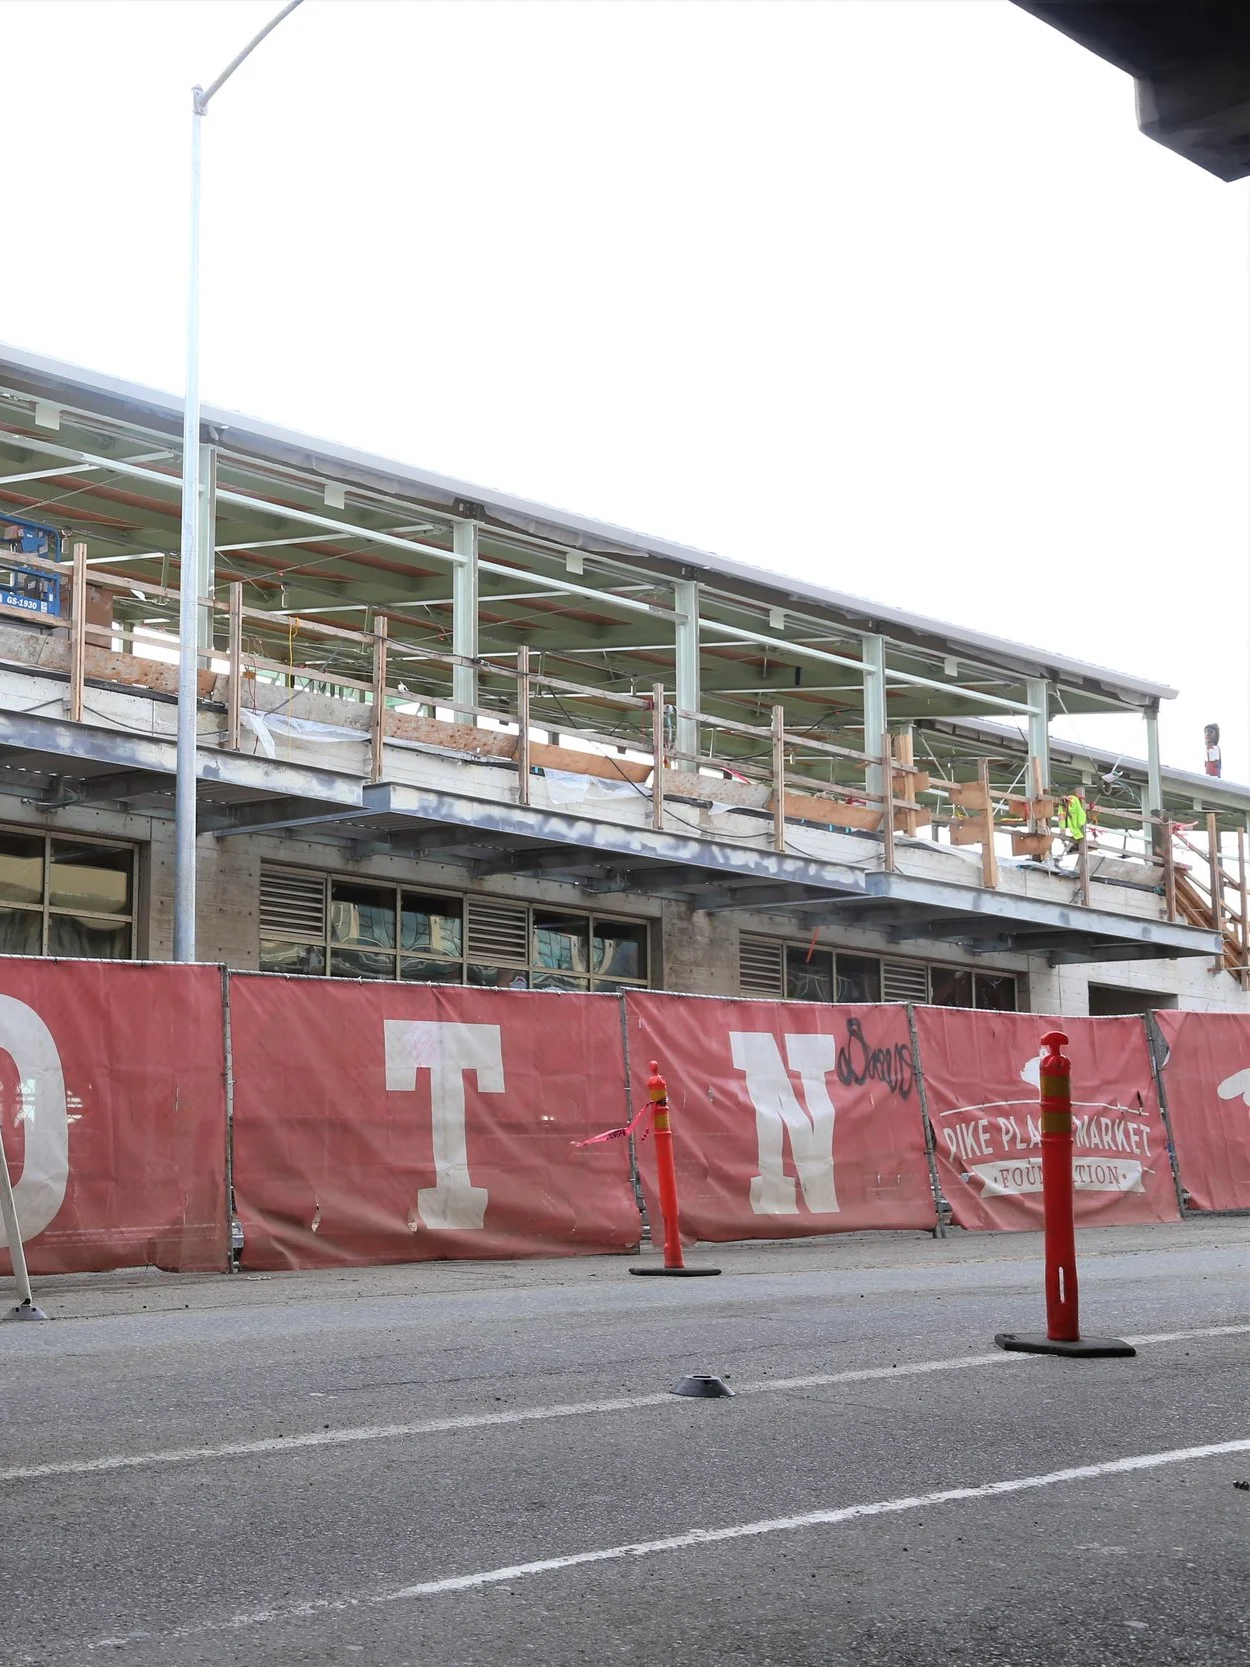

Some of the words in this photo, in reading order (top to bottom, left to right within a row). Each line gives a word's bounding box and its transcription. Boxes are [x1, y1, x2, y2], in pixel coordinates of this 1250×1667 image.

[6, 596, 38, 610] GS-1930
[383, 1019, 505, 1229] T
[729, 1031, 841, 1215] N
[943, 1119, 993, 1163] PIKE
[996, 1114, 1043, 1151] PLA
[1072, 1114, 1151, 1157] MARKET
[999, 1164, 1120, 1189] FOUTION
